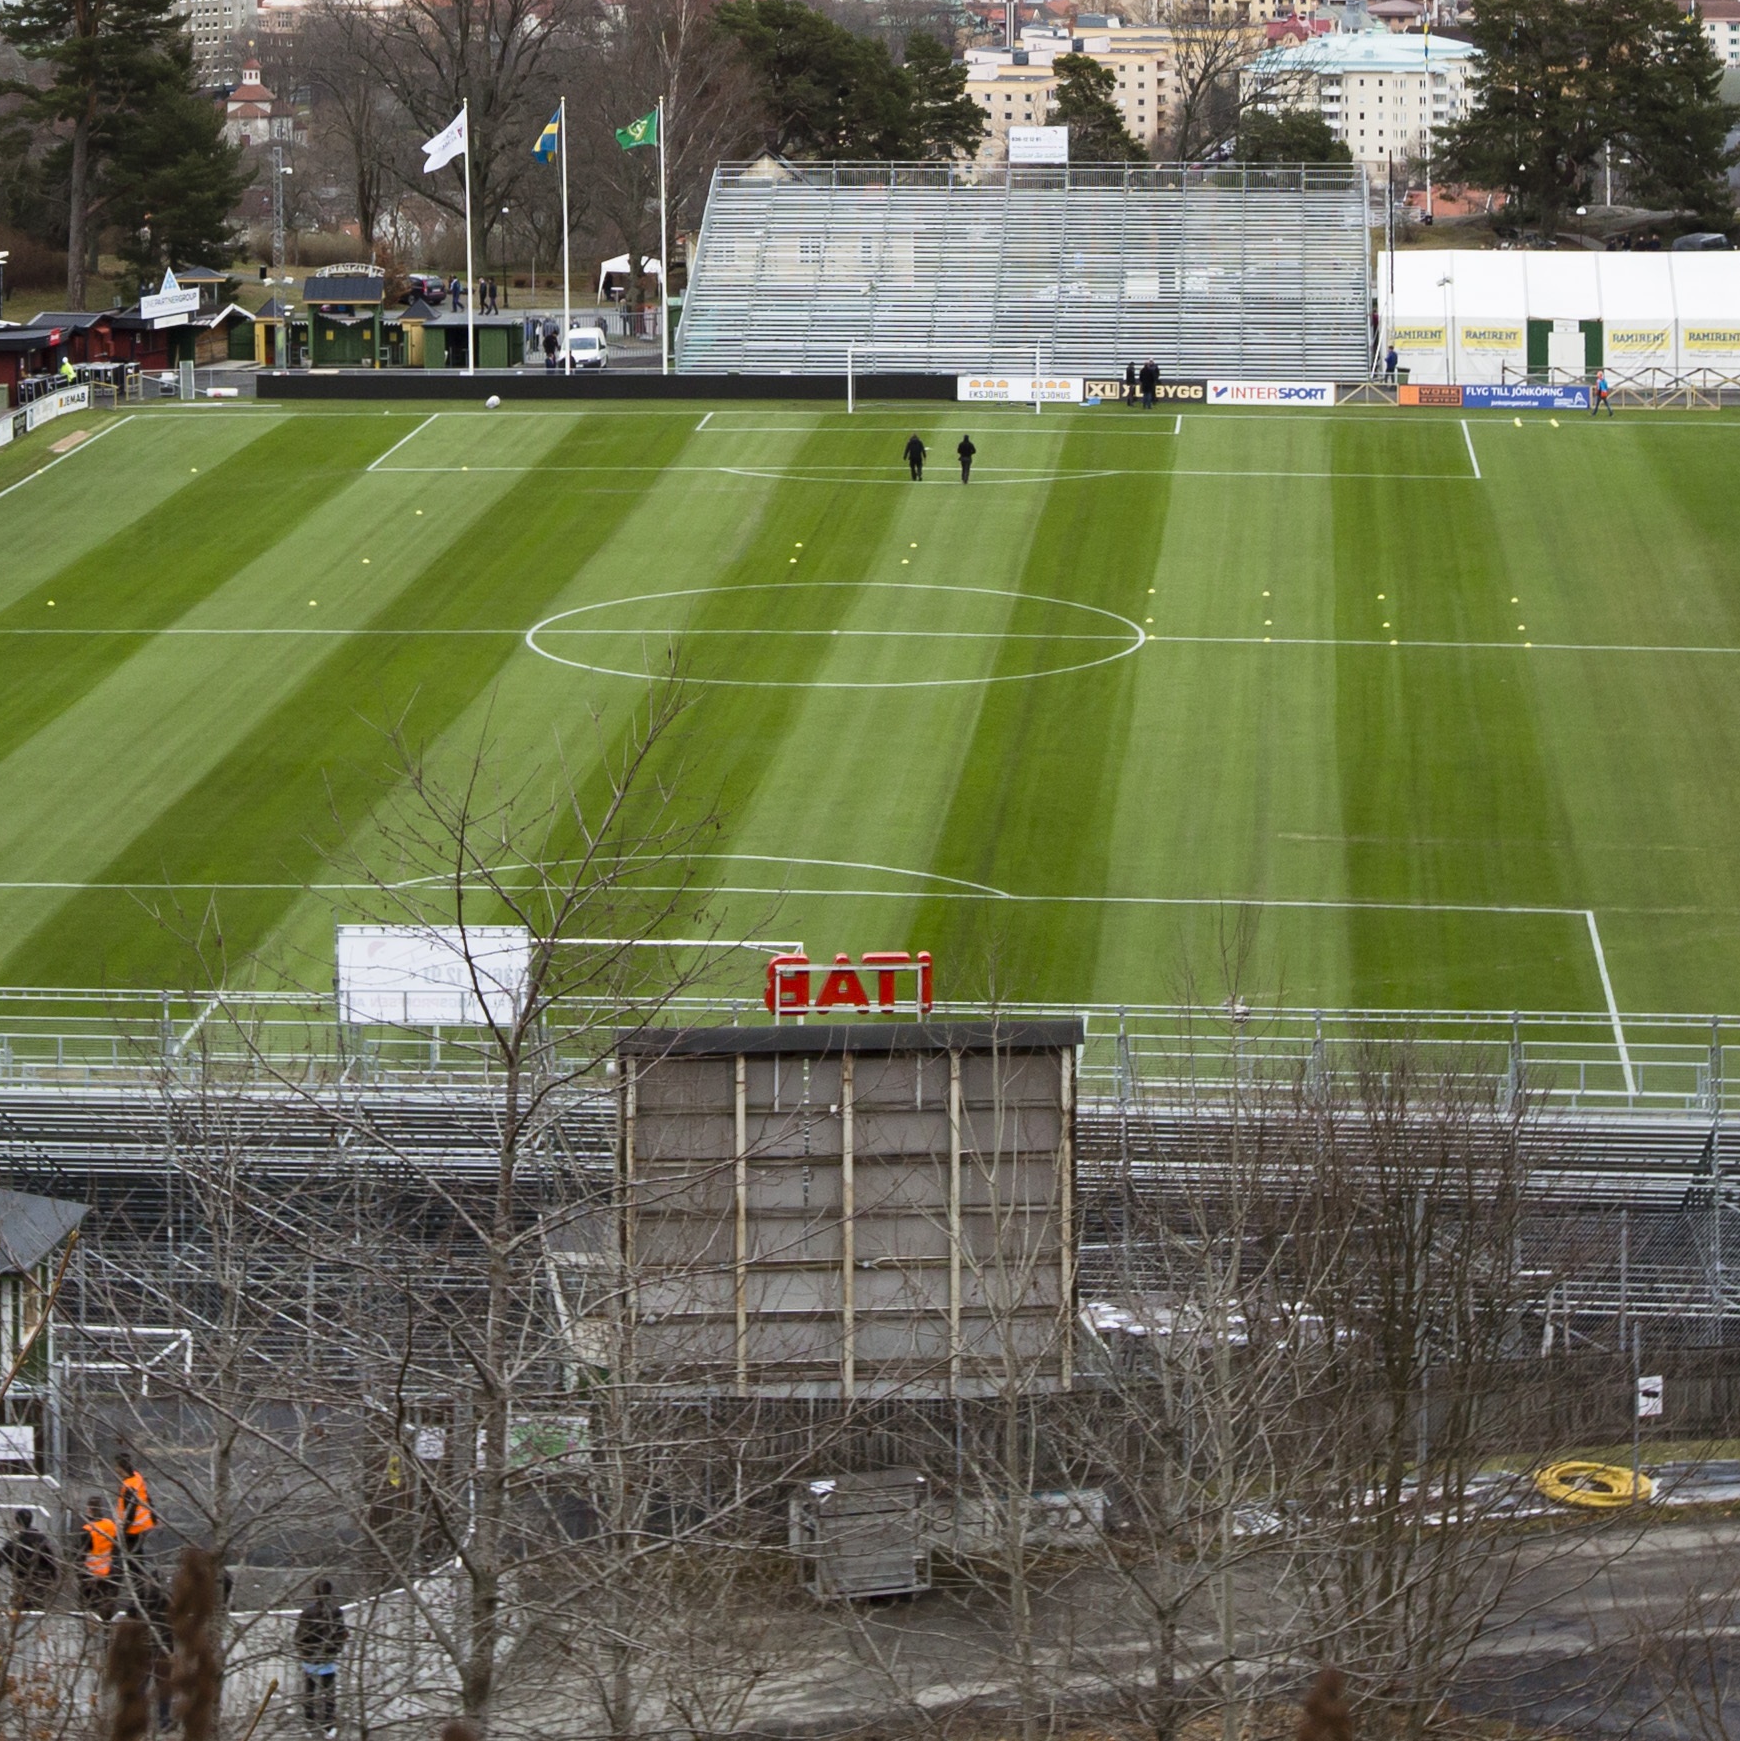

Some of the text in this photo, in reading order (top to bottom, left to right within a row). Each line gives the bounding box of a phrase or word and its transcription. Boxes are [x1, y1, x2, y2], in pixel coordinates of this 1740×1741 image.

[1465, 330, 1518, 341] RAMIRENT
[1612, 332, 1665, 343] RAMIRENT
[1688, 332, 1740, 342] RAMIRENT
[1030, 391, 1071, 400] ESJÖHUS
[1155, 385, 1203, 399] BYGG
[1230, 386, 1327, 400] INTERSPORT
[1420, 387, 1459, 396] WORK
[1466, 385, 1564, 397] FLYG TILL JÖNKÖPING
[63, 392, 86, 407] JEMAB
